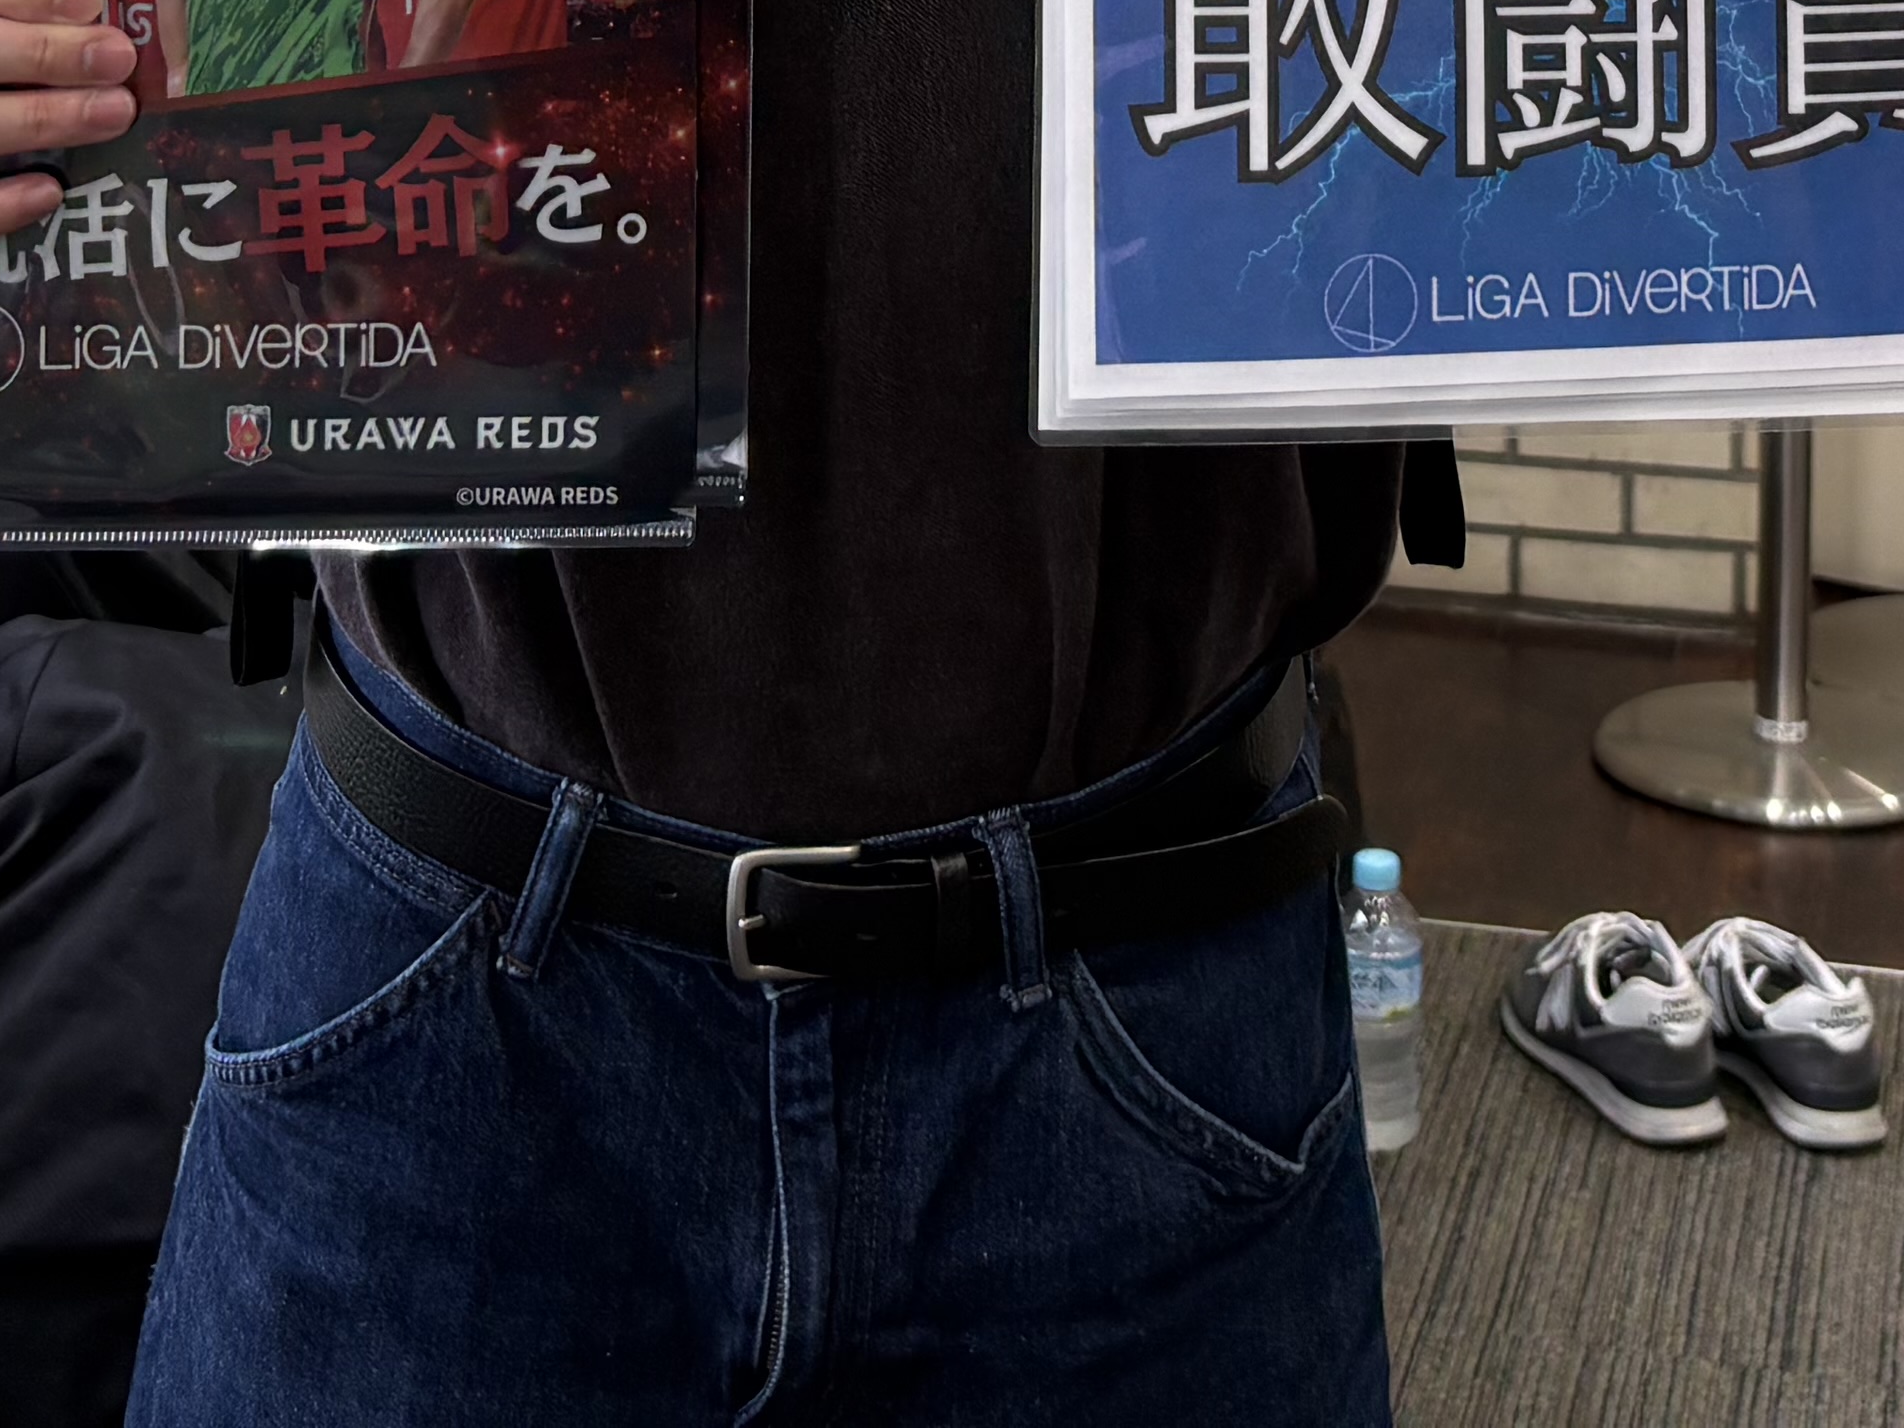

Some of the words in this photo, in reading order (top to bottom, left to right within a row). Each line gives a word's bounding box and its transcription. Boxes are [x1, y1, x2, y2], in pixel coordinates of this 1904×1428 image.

[289, 416, 456, 453] URAWA
[476, 415, 602, 451] REDS
[455, 486, 556, 508] ©URAWA
[561, 485, 620, 507] REDS
